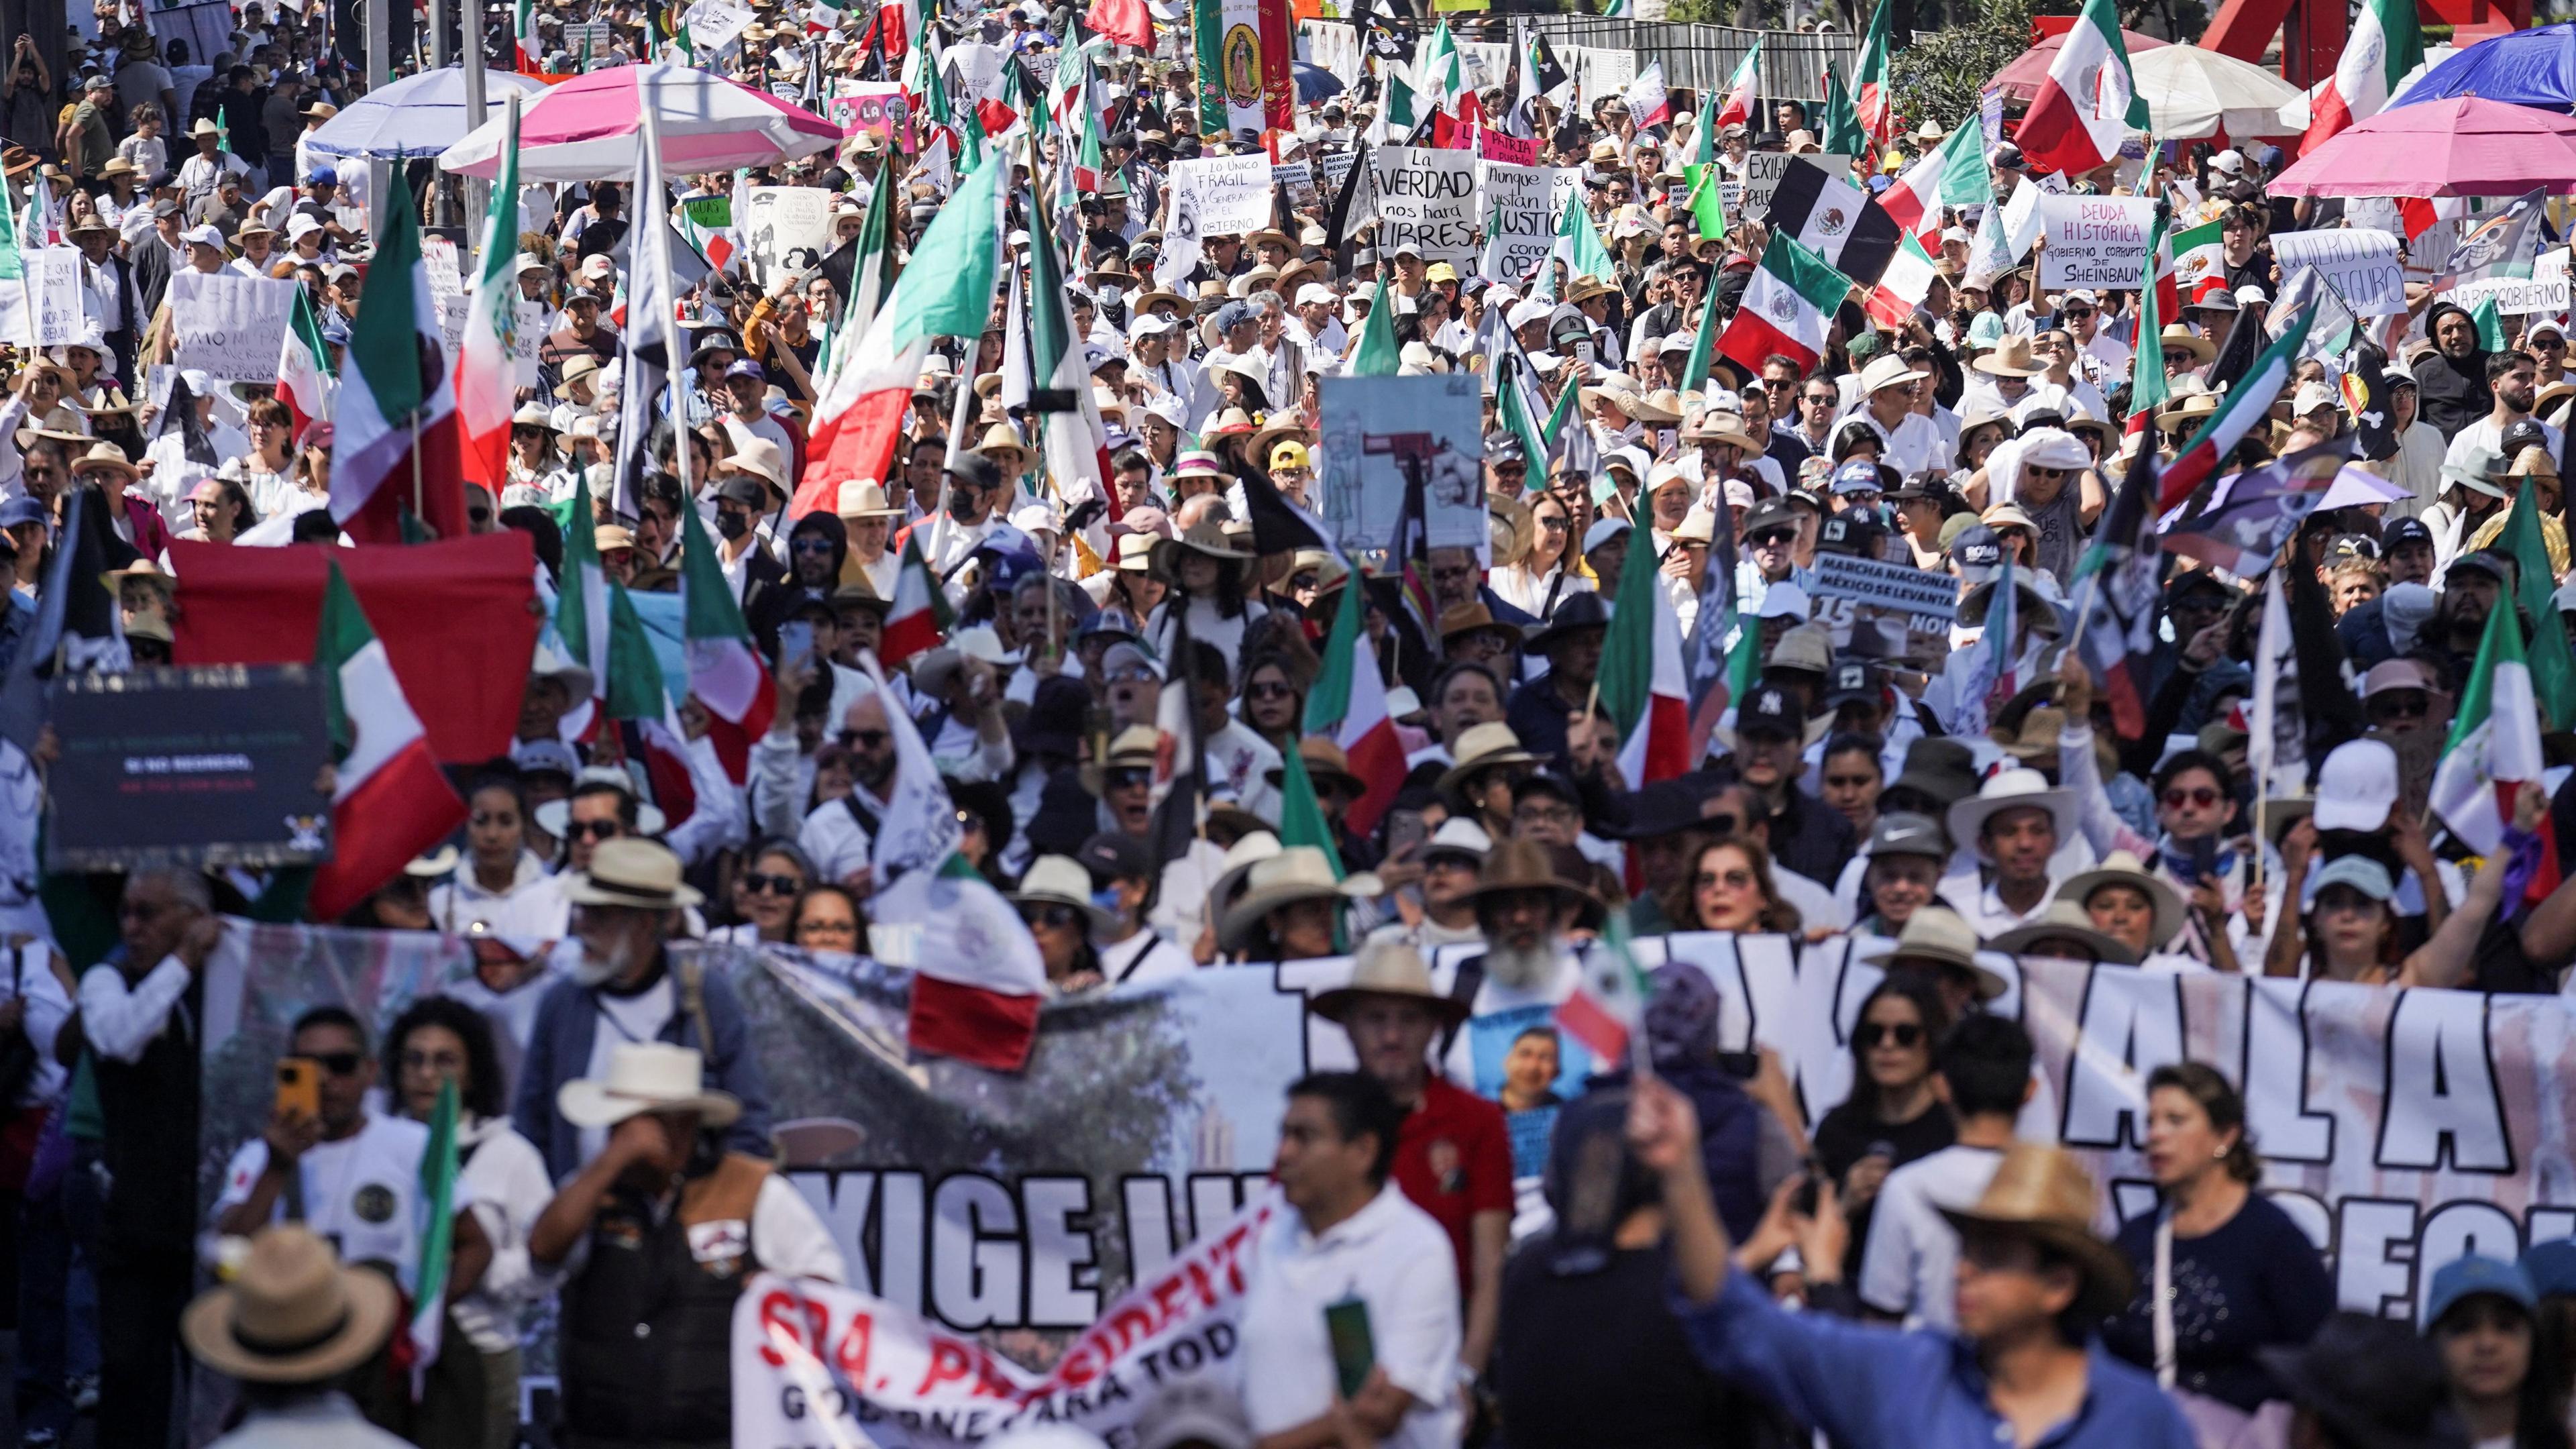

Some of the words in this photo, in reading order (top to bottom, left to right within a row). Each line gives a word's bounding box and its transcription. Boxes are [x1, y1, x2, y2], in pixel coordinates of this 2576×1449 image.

[863, 108, 880, 119] LA
[1492, 132, 1531, 154] PATRIA
[1210, 163, 1223, 173] LO
[1228, 158, 1258, 171] ÚNICO
[1325, 155, 1354, 164] MARCHA
[1412, 149, 1431, 166] La
[1279, 164, 1305, 173] NACIONAL
[1283, 171, 1308, 180] LEVANTA
[1326, 162, 1352, 172] MÉXICO
[1295, 180, 1313, 191] NOV
[1379, 168, 1473, 199] VERDAD
[1489, 167, 1541, 196] Aunque
[1554, 174, 1573, 186] se
[1547, 192, 1567, 211] de
[1205, 208, 1216, 216] ES
[1222, 206, 1234, 215] EL
[1386, 206, 1416, 217] nos
[1424, 204, 1462, 219] hará
[2082, 203, 2127, 221] DEUDA
[1202, 217, 1254, 233] OBIERNO
[2064, 221, 2141, 242] HISTÓRICA
[1377, 221, 1472, 249] LIBRES
[2047, 244, 2096, 262] GOBIERNO
[2105, 246, 2148, 259] CORRUPTO
[2278, 234, 2355, 269] QUIERO
[2359, 231, 2392, 260] UN
[2064, 264, 2145, 282] SHEINBAUM
[2328, 265, 2404, 309] SEGURO
[62, 309, 73, 321] DE
[213, 370, 276, 381] MIERDA
[1821, 557, 1884, 578] MARCHA
[1886, 568, 1957, 592] NACIONAL
[1819, 572, 1874, 594] MÉXICO
[1874, 584, 1892, 596] SE
[1893, 587, 1953, 608] LEVANTA
[1813, 594, 1859, 628] 15
[1910, 614, 1953, 636] NOV
